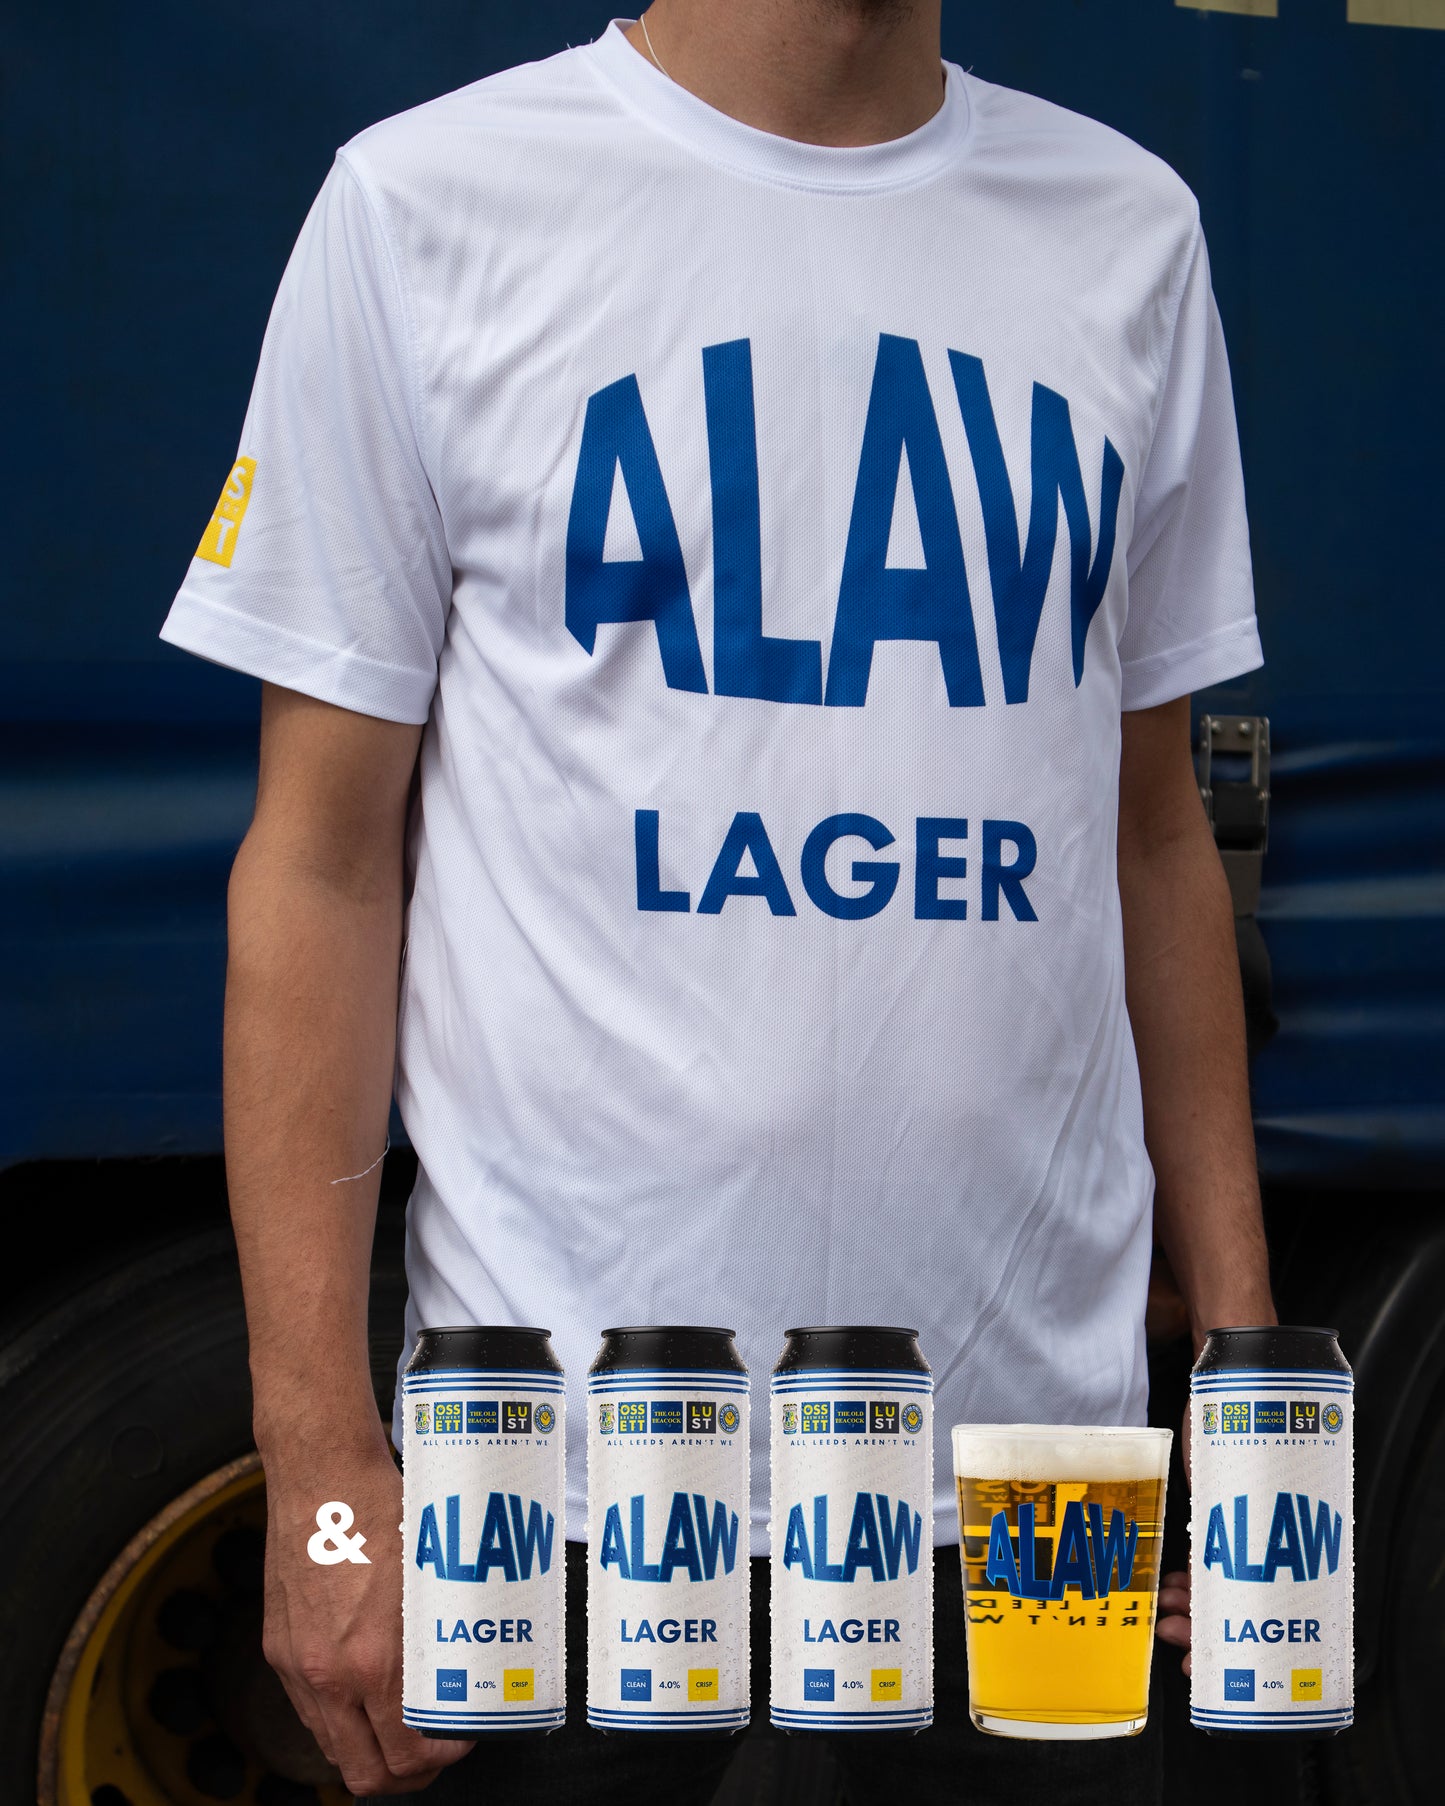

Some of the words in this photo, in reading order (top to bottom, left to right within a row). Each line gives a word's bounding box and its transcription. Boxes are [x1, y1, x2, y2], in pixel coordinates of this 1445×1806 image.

[565, 333, 1125, 707] ALAW
[635, 809, 1039, 921] LAGER
[435, 1404, 461, 1415] OSS
[507, 1405, 528, 1417] LU
[619, 1404, 645, 1415] OSS
[691, 1405, 712, 1417] LU
[803, 1404, 829, 1415] OSS
[875, 1405, 896, 1417] LU
[1223, 1404, 1249, 1415] OSS
[1295, 1405, 1316, 1417] LU
[435, 1420, 461, 1432] ETT
[507, 1418, 528, 1430] ST
[619, 1420, 645, 1432] ETT
[691, 1418, 712, 1430] ST
[803, 1420, 829, 1432] ETT
[875, 1418, 896, 1430] ST
[1223, 1420, 1249, 1432] ETT
[1295, 1418, 1316, 1430] ST
[415, 1492, 555, 1583] ALAW
[599, 1492, 739, 1583] ALAW
[783, 1492, 923, 1583] ALAW
[1203, 1492, 1343, 1583] ALAW
[986, 1501, 1139, 1600] ALAW
[436, 1618, 534, 1643] LAGER
[620, 1618, 718, 1643] LAGER
[804, 1618, 902, 1643] LAGER
[1224, 1618, 1322, 1643] LAGER
[474, 1681, 496, 1689] 4.0%
[658, 1681, 680, 1689] 4.0%
[842, 1681, 864, 1689] 4.0%
[1262, 1681, 1284, 1689] 4.0%
